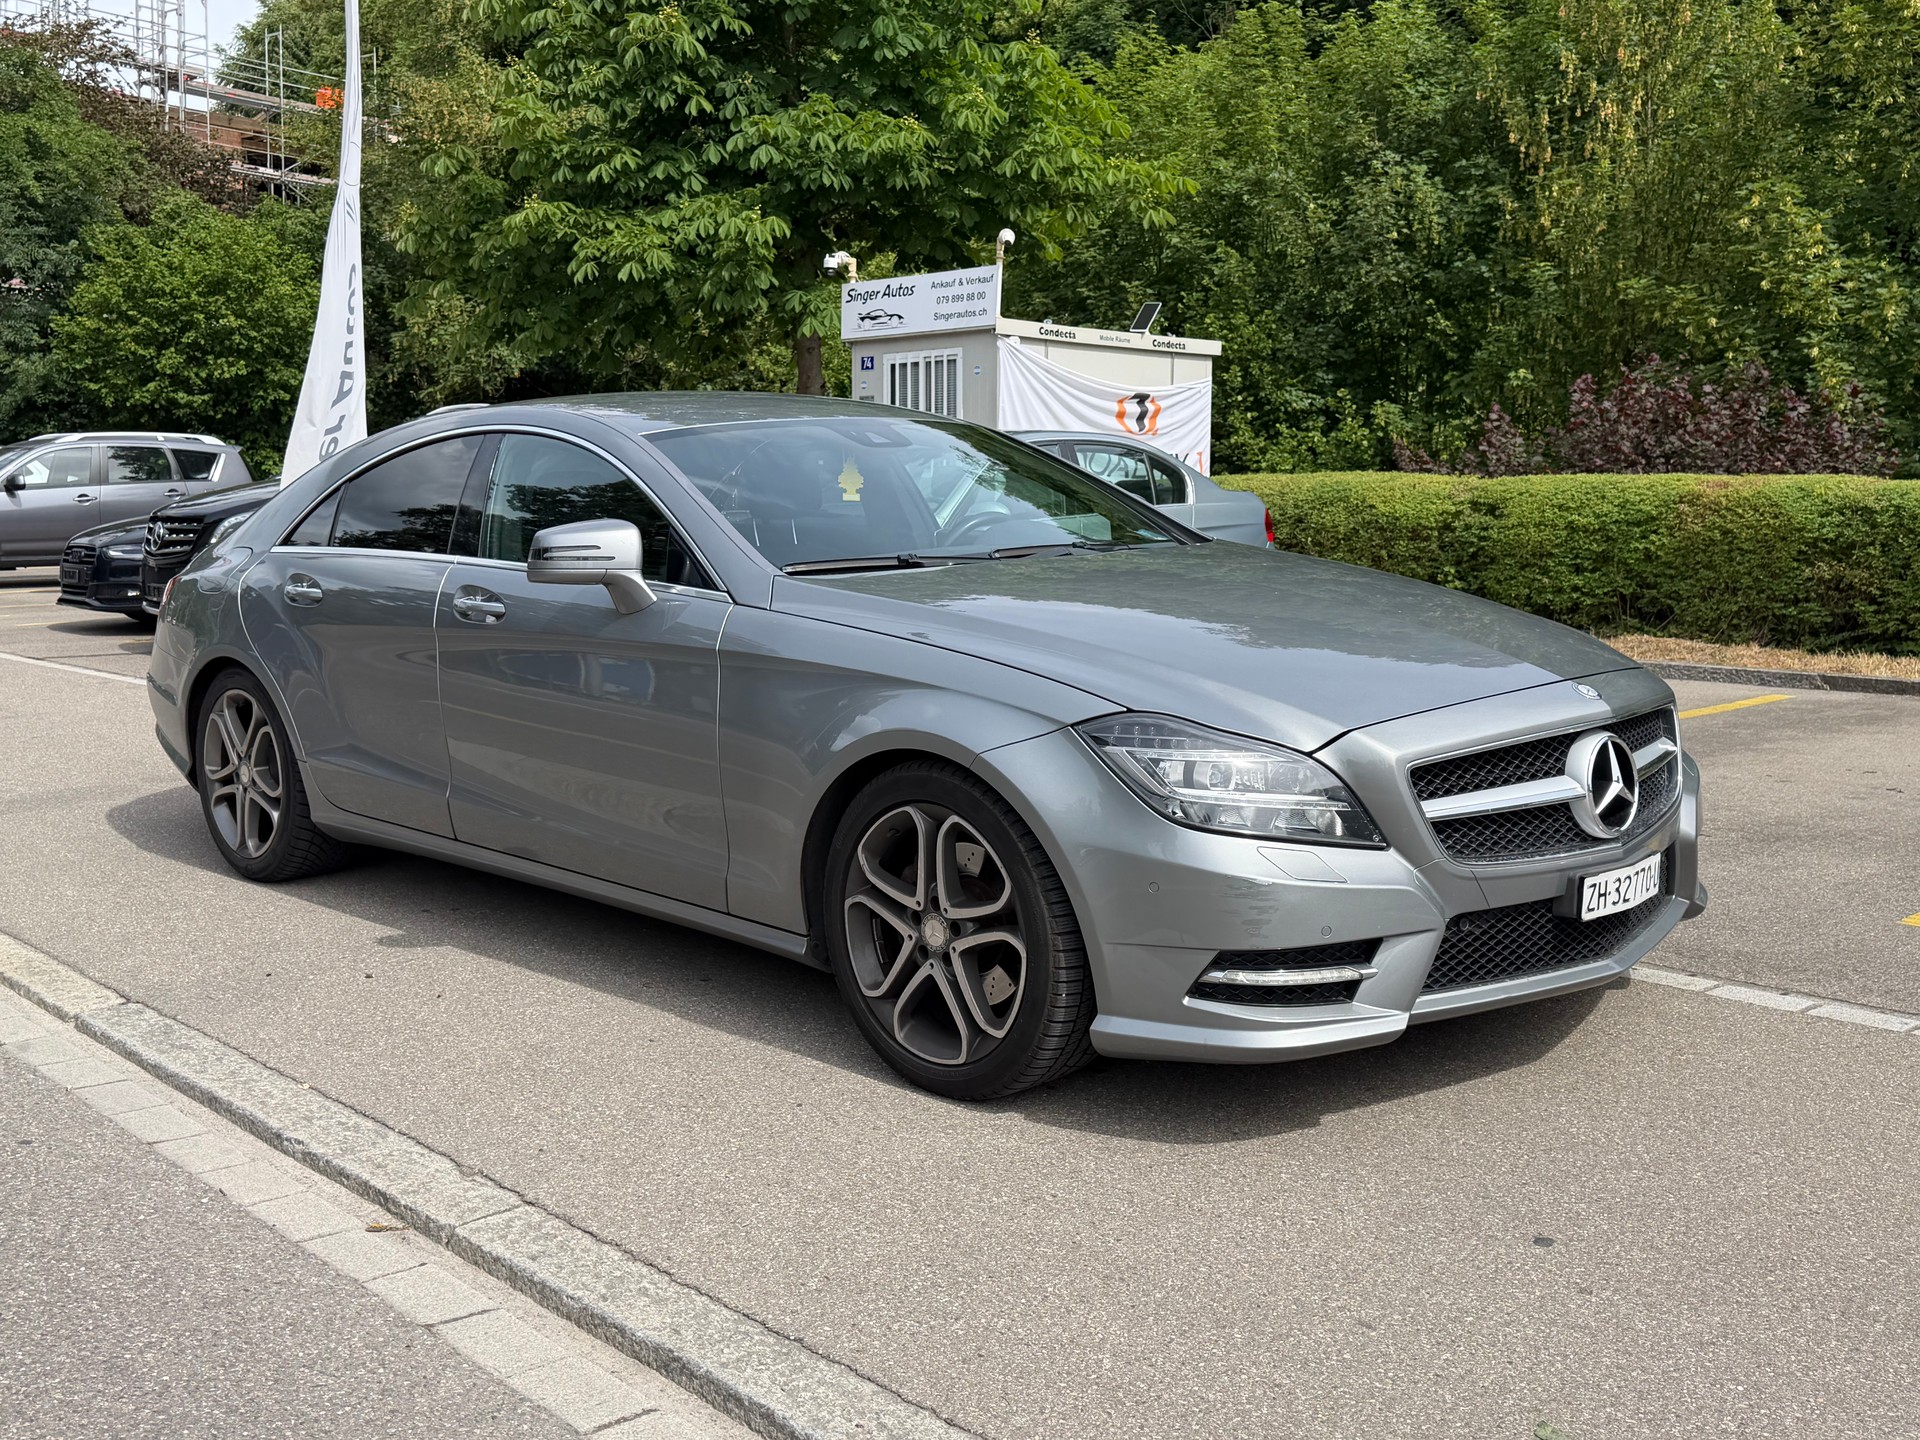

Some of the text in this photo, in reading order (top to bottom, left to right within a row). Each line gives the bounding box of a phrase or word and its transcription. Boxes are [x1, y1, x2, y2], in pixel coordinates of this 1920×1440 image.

[931, 274, 994, 290] Ankauf & Verkauf
[845, 284, 916, 304] Singer Autos
[936, 291, 986, 305] 079 899 88 00
[933, 307, 987, 322] Singerautos.ch
[1039, 326, 1076, 339] Condecta
[1099, 334, 1114, 342] Mobile
[1152, 339, 1186, 350] Condecta
[863, 357, 872, 369] 74
